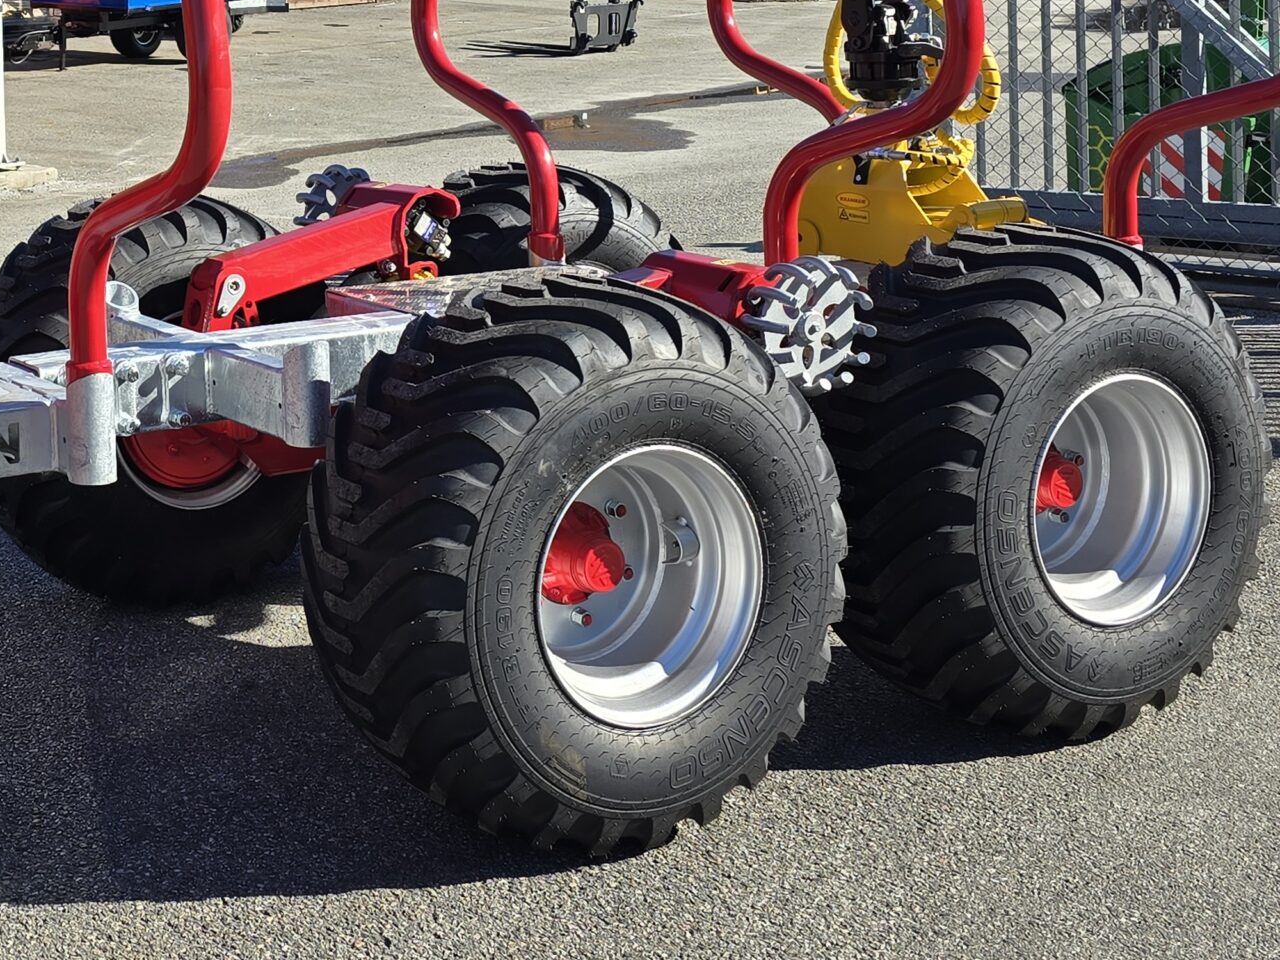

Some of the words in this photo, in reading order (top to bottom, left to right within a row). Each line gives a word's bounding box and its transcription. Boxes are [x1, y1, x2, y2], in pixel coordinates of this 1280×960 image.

[570, 391, 758, 449] 400/60-15.5
[996, 490, 1091, 673] ASCENSO
[669, 595, 812, 790] ASCENSO
